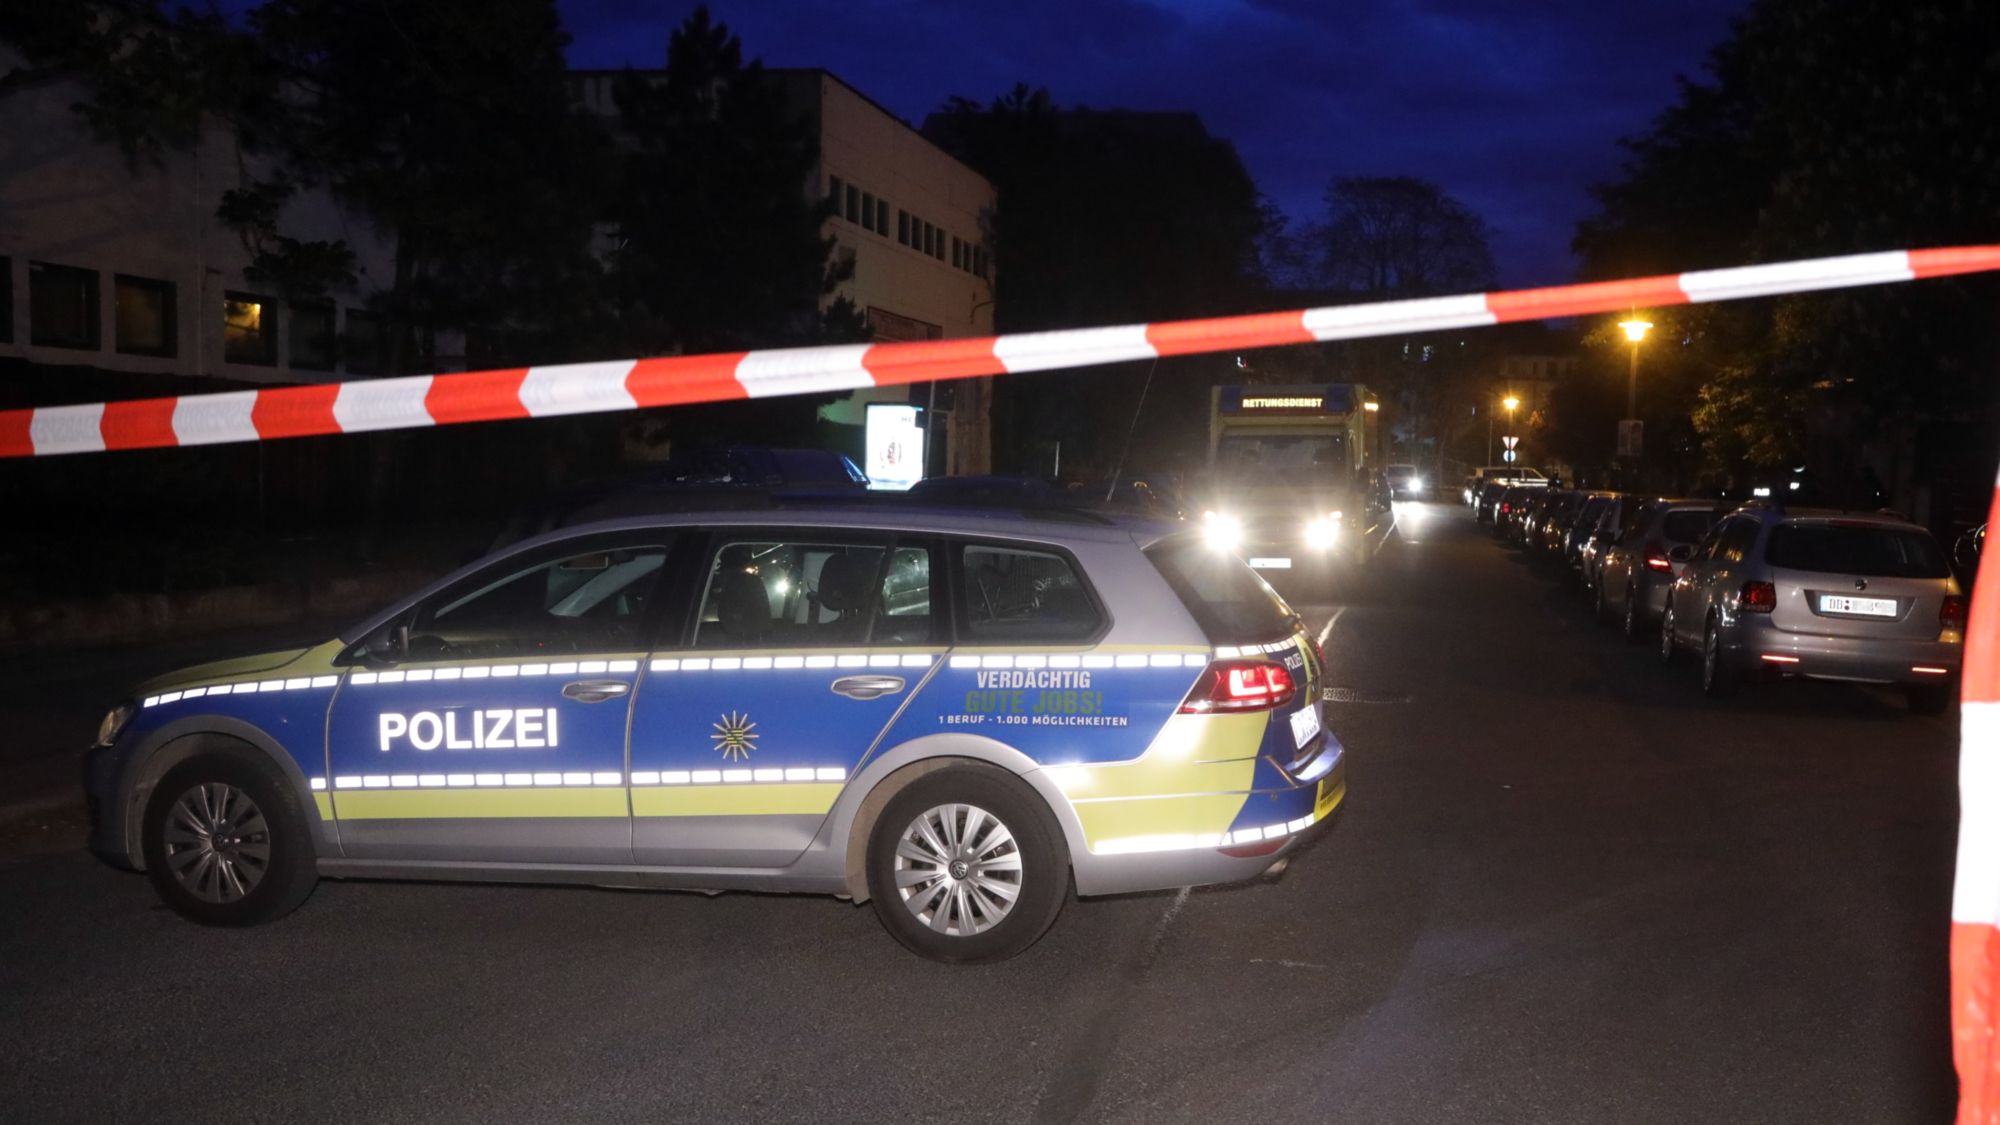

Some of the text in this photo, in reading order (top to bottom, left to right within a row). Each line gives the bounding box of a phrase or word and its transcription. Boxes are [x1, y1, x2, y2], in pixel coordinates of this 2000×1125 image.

[1242, 398, 1323, 408] RETTUNGSDIENST
[976, 667, 1091, 689] VERDÄCHTIG
[964, 690, 1103, 714] GUTE JOBS!
[379, 708, 558, 751] POLIZEI
[938, 715, 944, 724] 1
[947, 715, 985, 724] BERUF
[996, 715, 1028, 724] 1.000
[1032, 714, 1128, 726] MÖGLICHKEITEN
